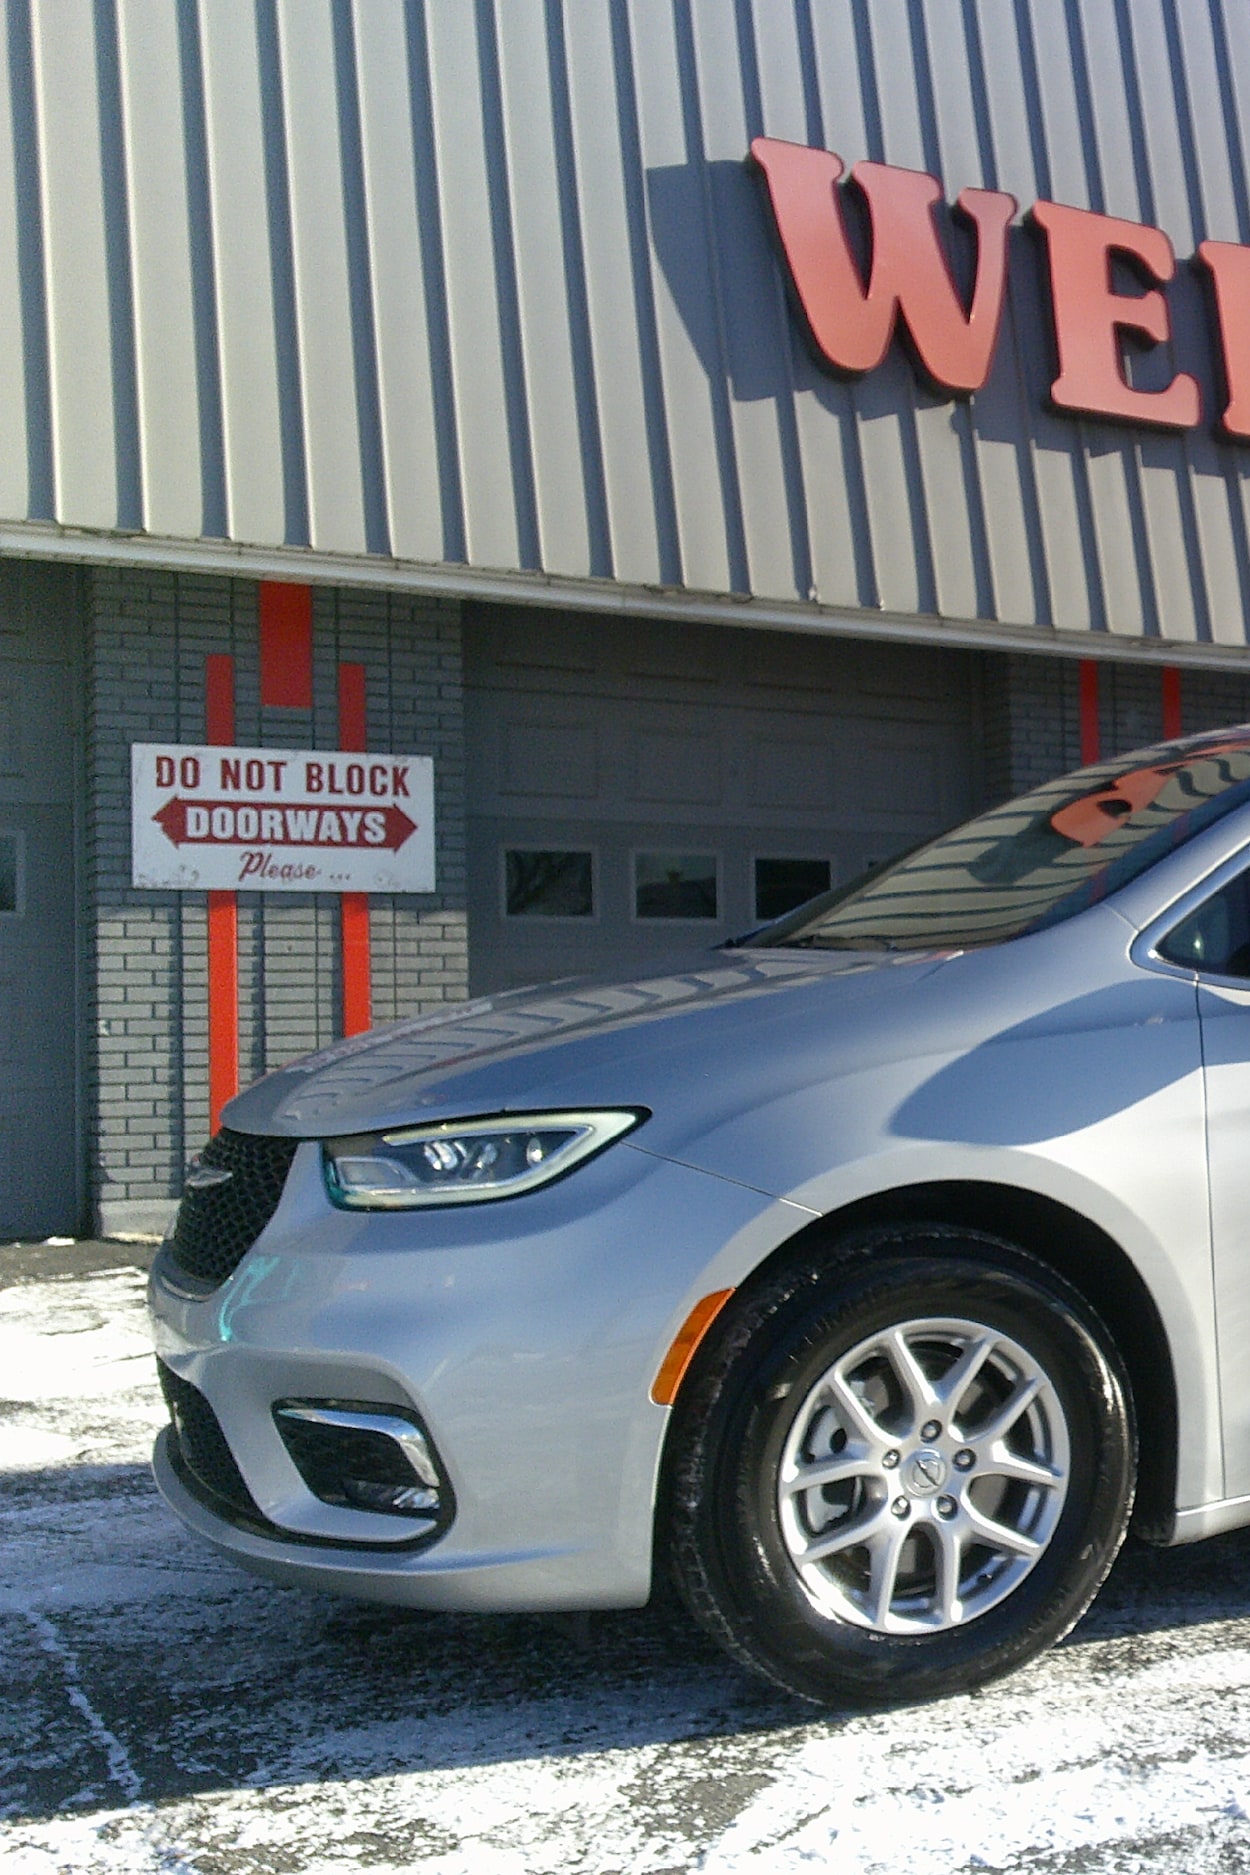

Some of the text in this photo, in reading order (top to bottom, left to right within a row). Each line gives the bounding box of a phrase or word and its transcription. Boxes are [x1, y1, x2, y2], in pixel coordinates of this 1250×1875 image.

[156, 756, 410, 797] DO NOT BLOCK
[185, 806, 387, 843] DOORWAYS
[238, 851, 317, 882] Please
